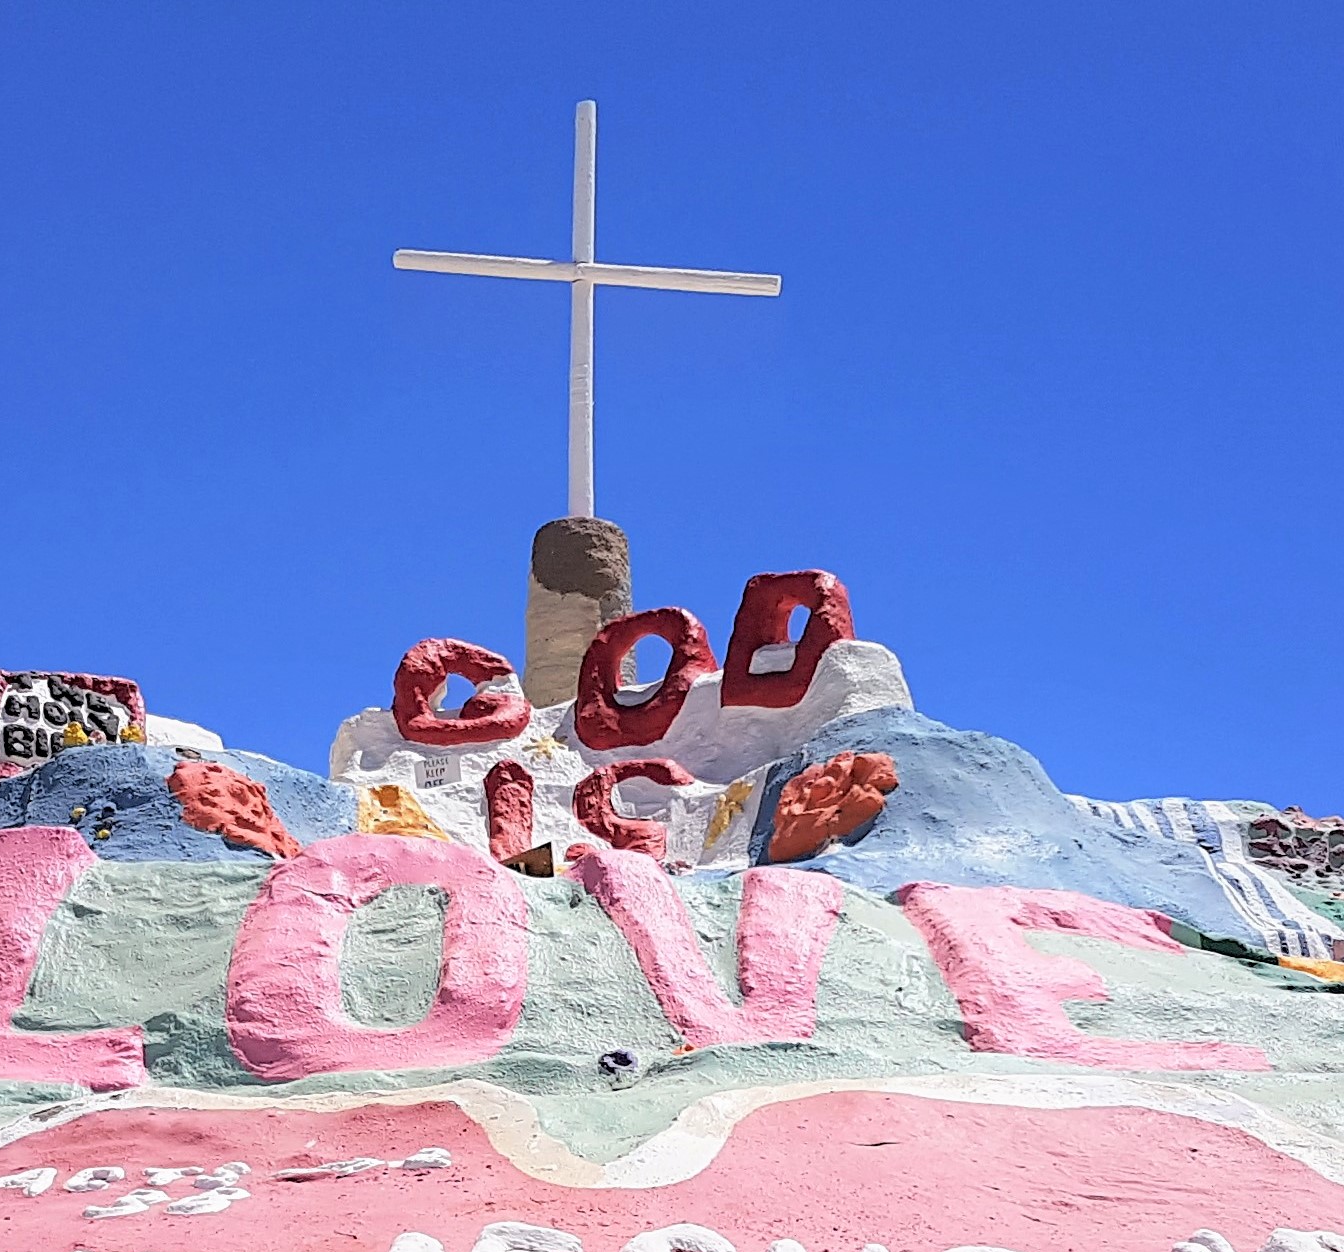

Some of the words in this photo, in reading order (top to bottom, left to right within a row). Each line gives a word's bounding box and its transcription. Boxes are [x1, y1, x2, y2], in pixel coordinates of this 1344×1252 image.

[392, 570, 854, 750] GOD
[423, 756, 449, 768] PLEASE
[485, 758, 696, 862] IS
